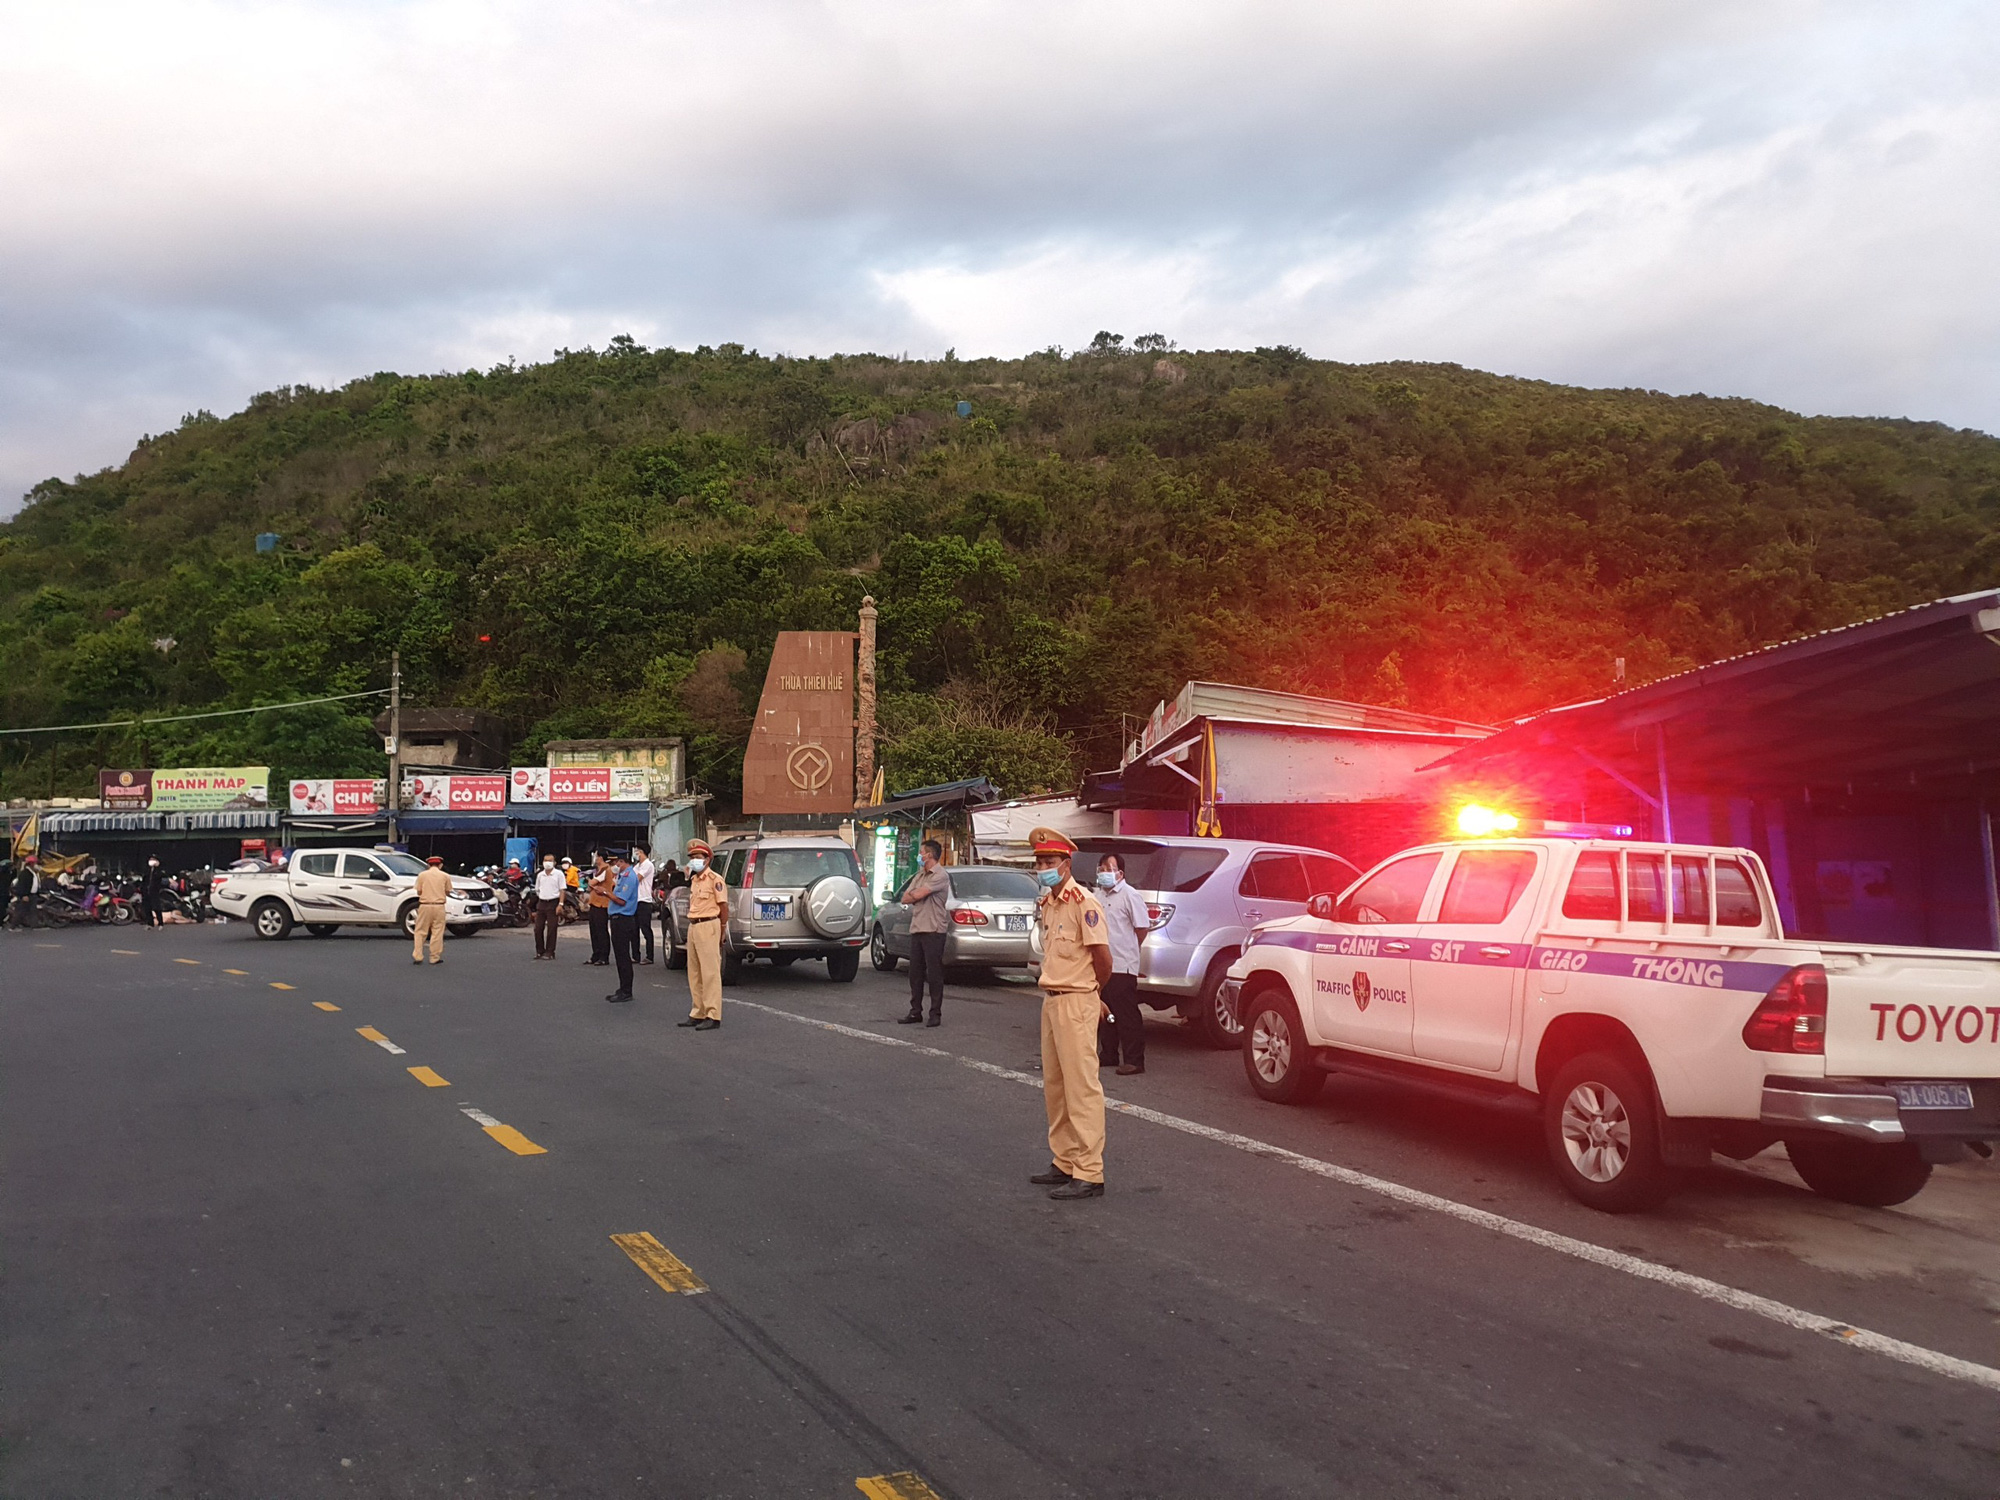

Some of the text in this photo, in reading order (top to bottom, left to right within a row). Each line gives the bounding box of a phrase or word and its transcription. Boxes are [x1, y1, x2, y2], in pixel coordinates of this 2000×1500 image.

[156, 779, 207, 790] THANH
[552, 780, 573, 793] CÔ
[335, 792, 359, 806] CHỊ
[451, 788, 502, 803] CÔ HAI
[1429, 940, 1466, 962] SÁT
[1539, 949, 1588, 971] GIAO
[1632, 958, 1724, 988] THÔNG
[1316, 979, 1351, 996] TRAFFIC
[1373, 987, 1407, 1004] POLICE
